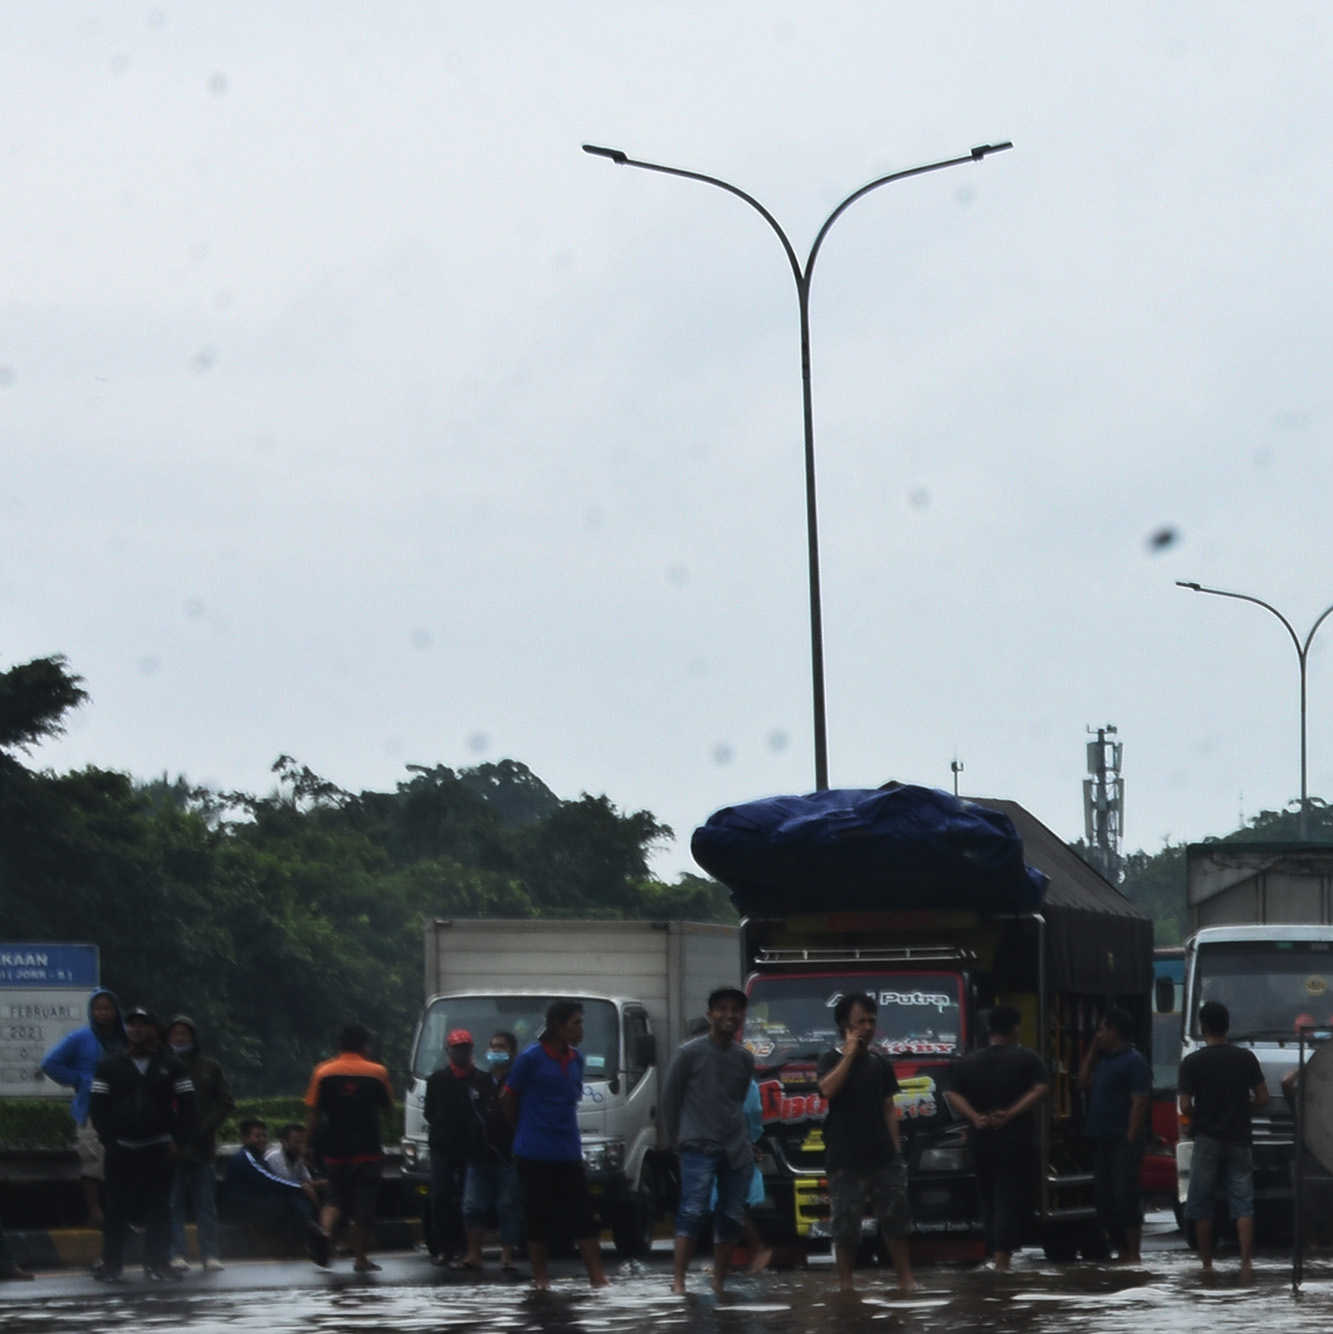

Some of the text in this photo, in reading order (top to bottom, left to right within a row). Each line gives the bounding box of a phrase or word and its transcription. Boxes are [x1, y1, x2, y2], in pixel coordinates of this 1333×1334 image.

[879, 991, 951, 1006] Putra
[10, 1006, 71, 1018] FEBRUARI
[10, 1026, 43, 1039] 2021
